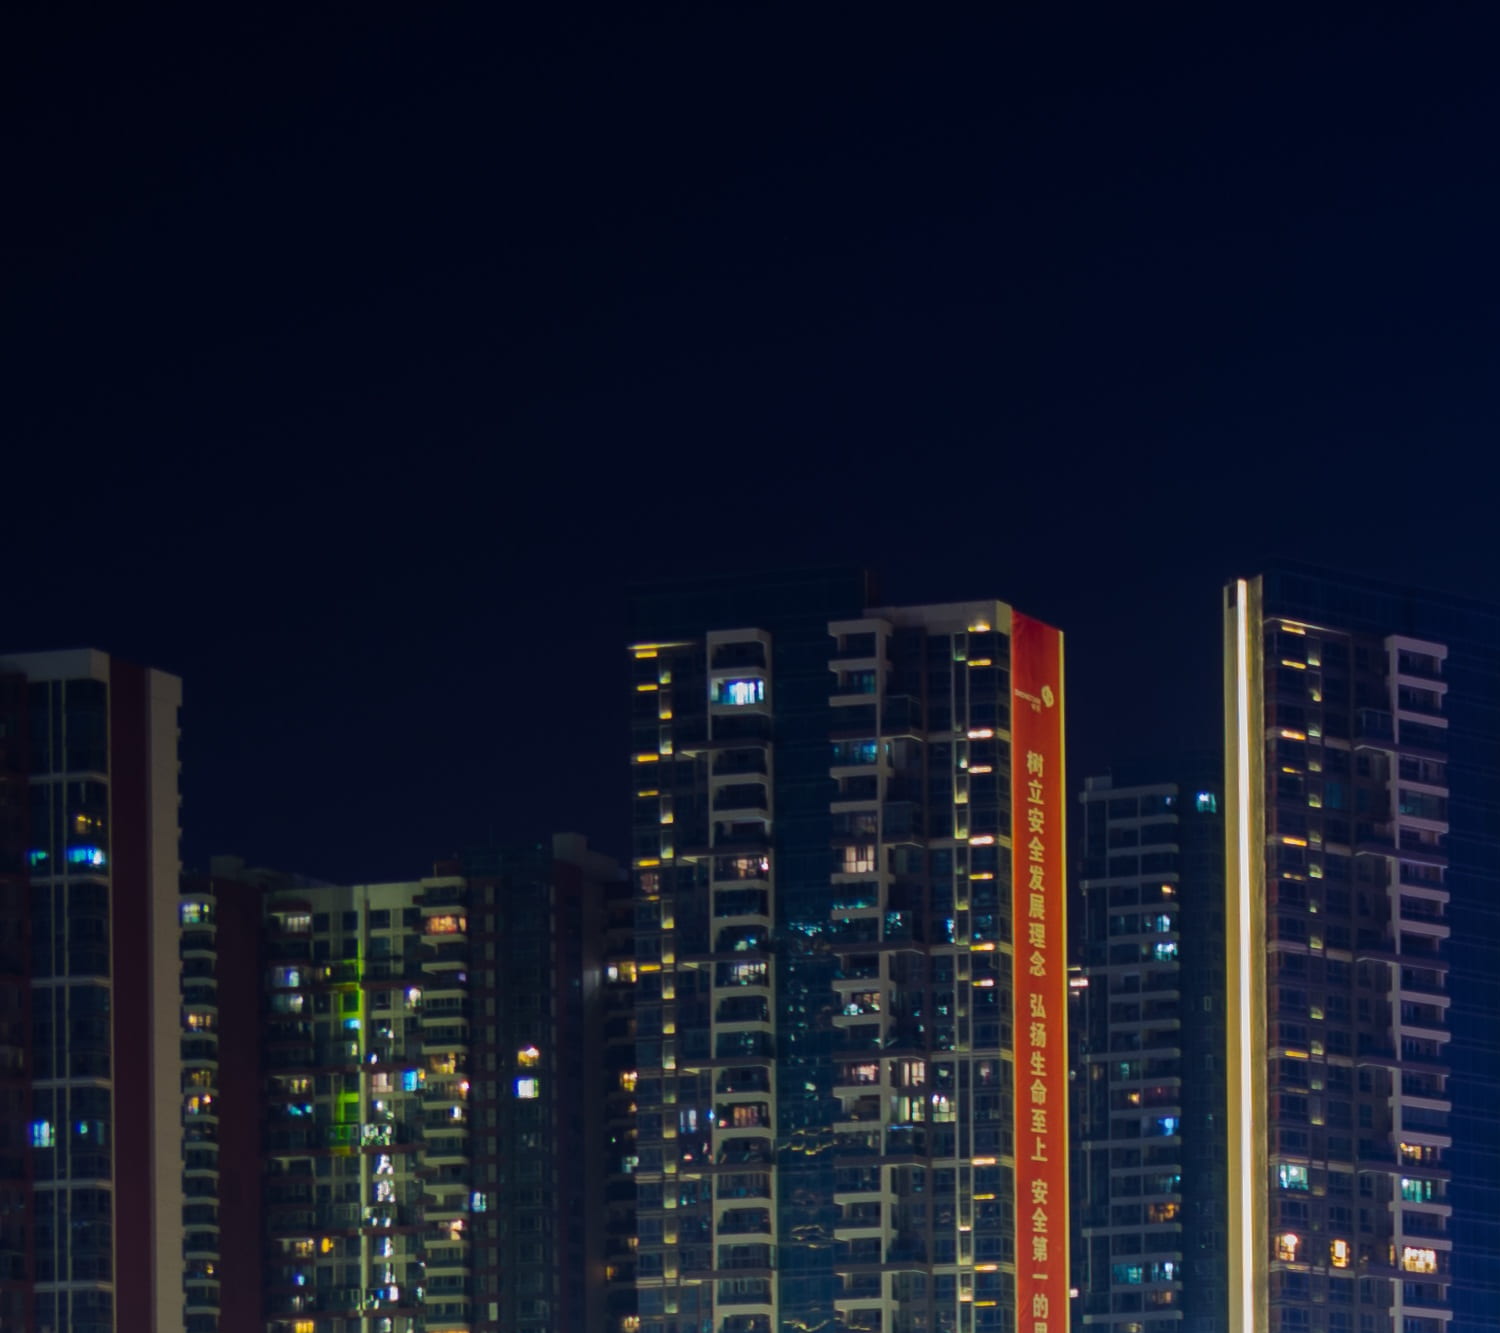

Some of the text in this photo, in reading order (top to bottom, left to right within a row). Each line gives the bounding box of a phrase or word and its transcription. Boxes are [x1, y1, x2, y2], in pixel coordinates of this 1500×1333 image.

[1026, 750, 1045, 976] 树立安全发展理念
[1029, 993, 1047, 1162] 弘扬生命至上
